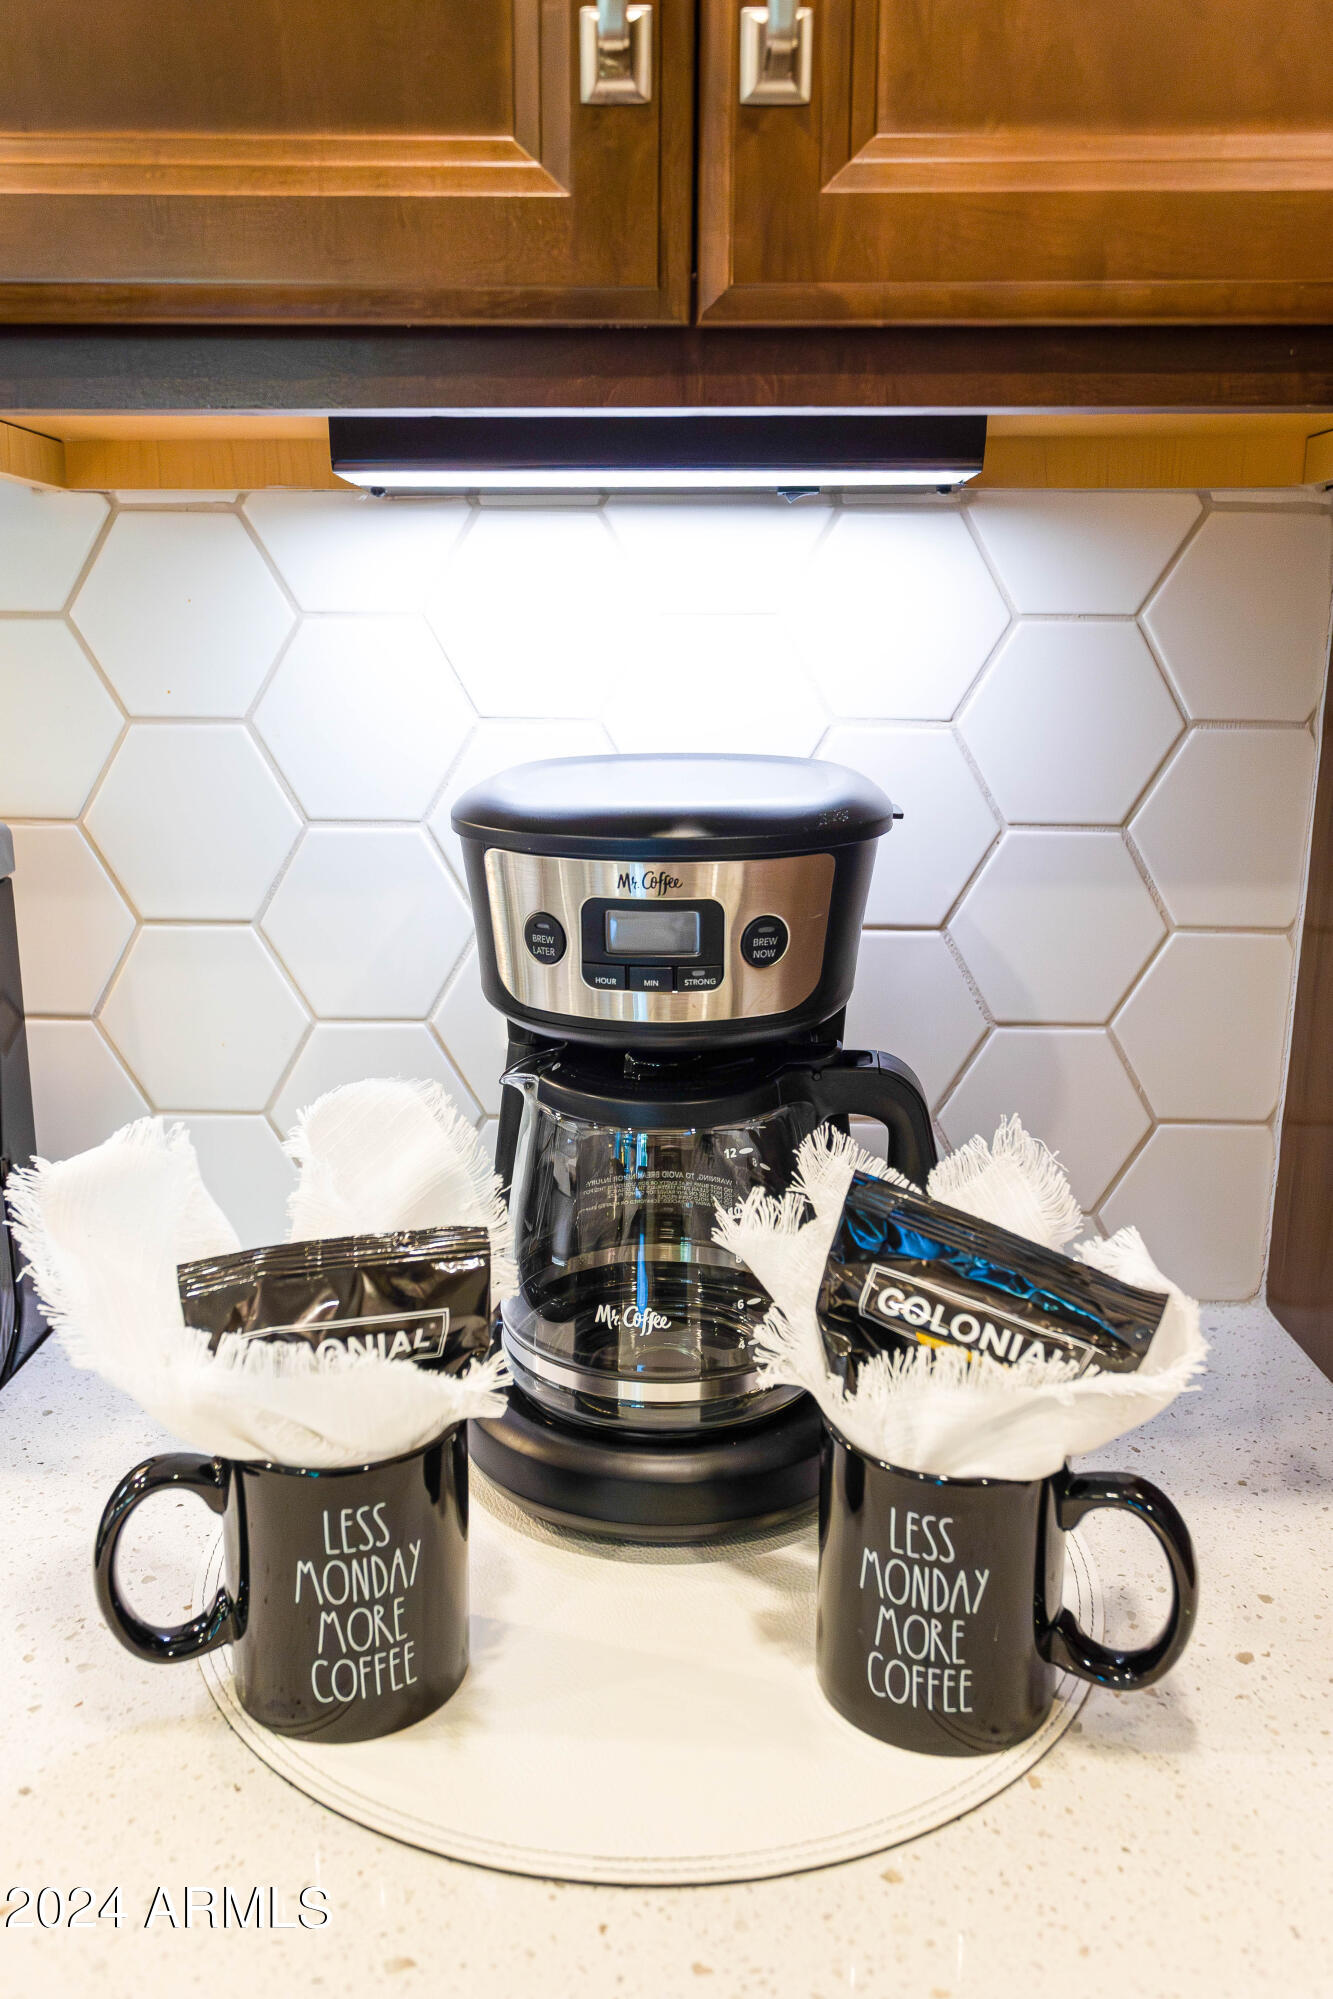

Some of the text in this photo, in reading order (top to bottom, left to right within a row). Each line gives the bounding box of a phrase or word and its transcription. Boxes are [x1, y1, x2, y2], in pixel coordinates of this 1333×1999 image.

[617, 870, 683, 897] Mr. Coffee
[532, 934, 555, 945] BREW
[532, 946, 556, 957] LATER
[753, 936, 778, 948] BREW
[753, 948, 776, 959] NOW
[595, 976, 617, 986] HOUR
[643, 979, 659, 987] MIN
[684, 977, 716, 987] STRONG
[724, 1148, 737, 1159] 12
[737, 1299, 745, 1310] 6
[595, 1304, 672, 1337] Mr. Coffee
[250, 1328, 431, 1363] ONIAL
[323, 1502, 390, 1555] LESS
[890, 1506, 955, 1563] LESS
[295, 1539, 421, 1605] MONDAY
[859, 1547, 990, 1615] MONDAY
[318, 1596, 408, 1655] MORE
[875, 1604, 966, 1665] MORE
[311, 1640, 418, 1704] COFFEE
[867, 1651, 974, 1713] COFFEE
